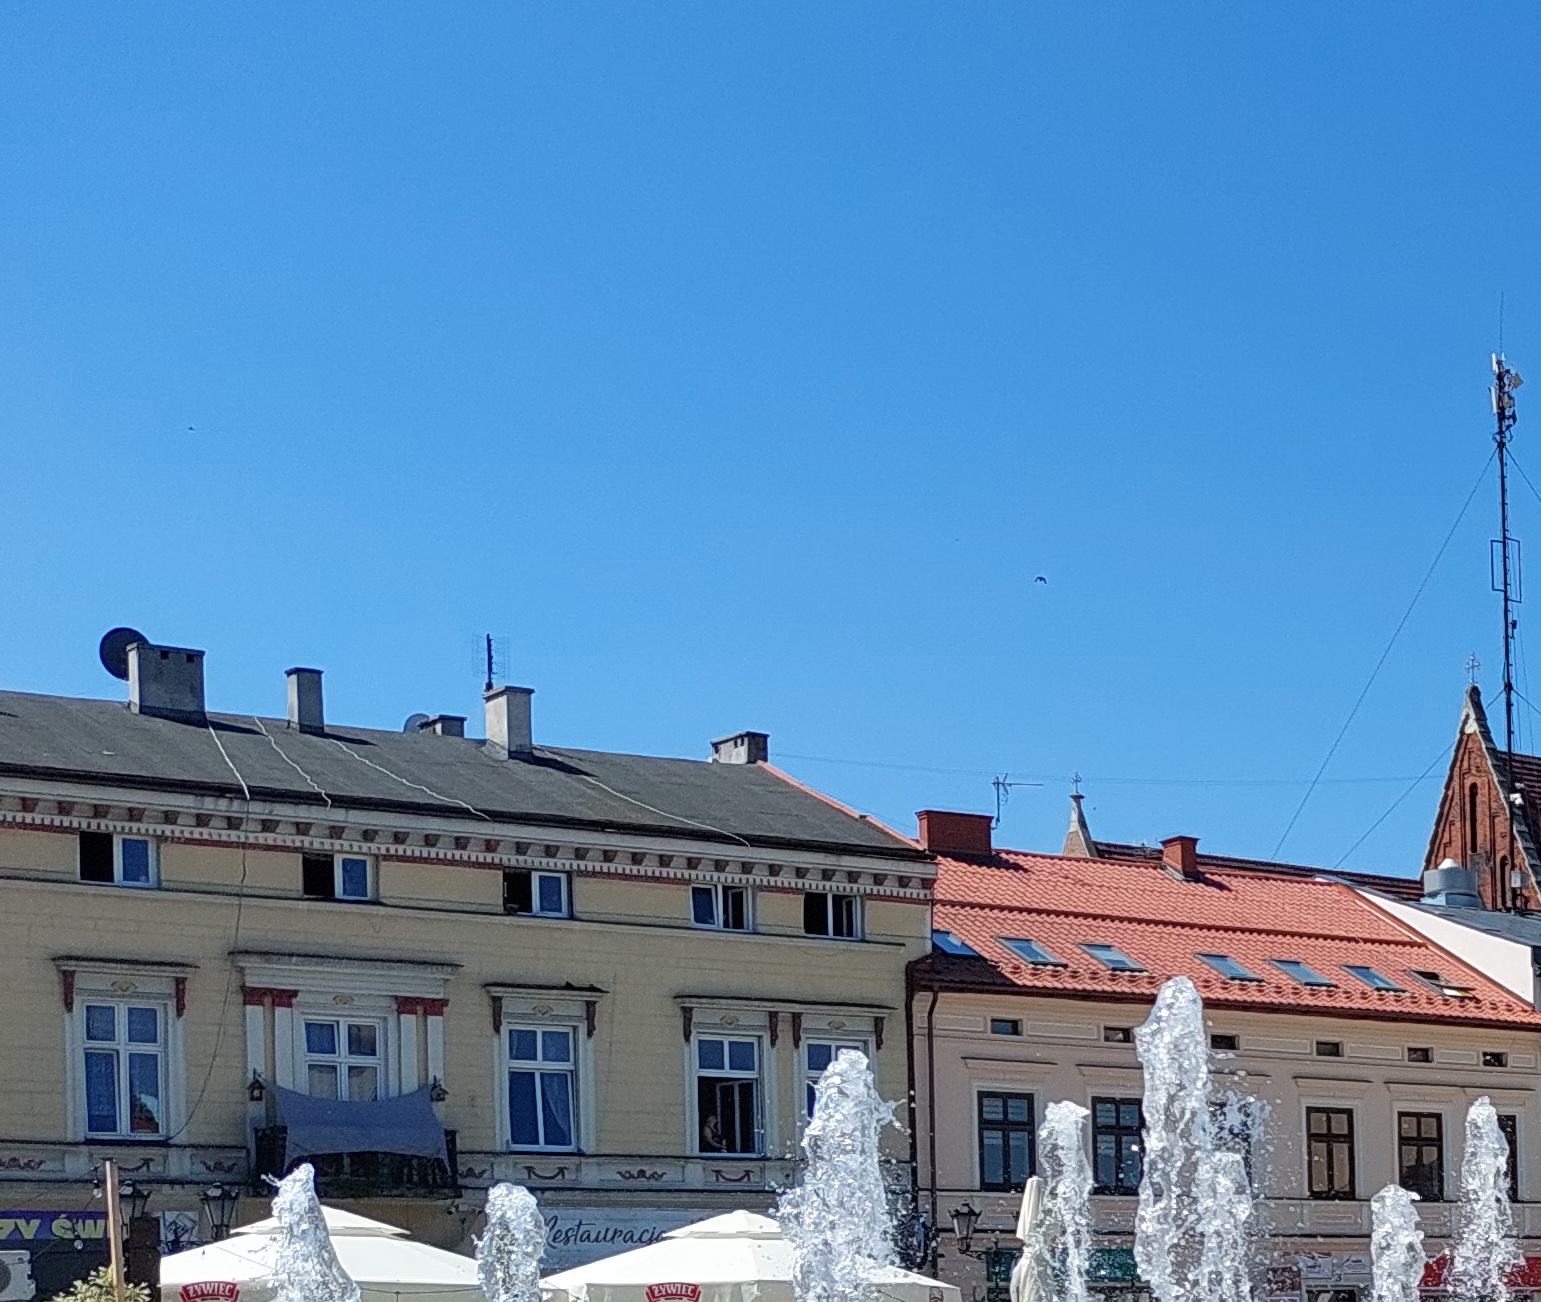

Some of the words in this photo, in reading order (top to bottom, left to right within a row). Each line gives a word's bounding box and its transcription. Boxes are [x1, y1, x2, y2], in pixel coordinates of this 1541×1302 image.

[51, 1213, 110, 1239] ŚW
[187, 1282, 233, 1299] ŻYWIEC
[652, 1284, 696, 1297] ŻYWIEC
